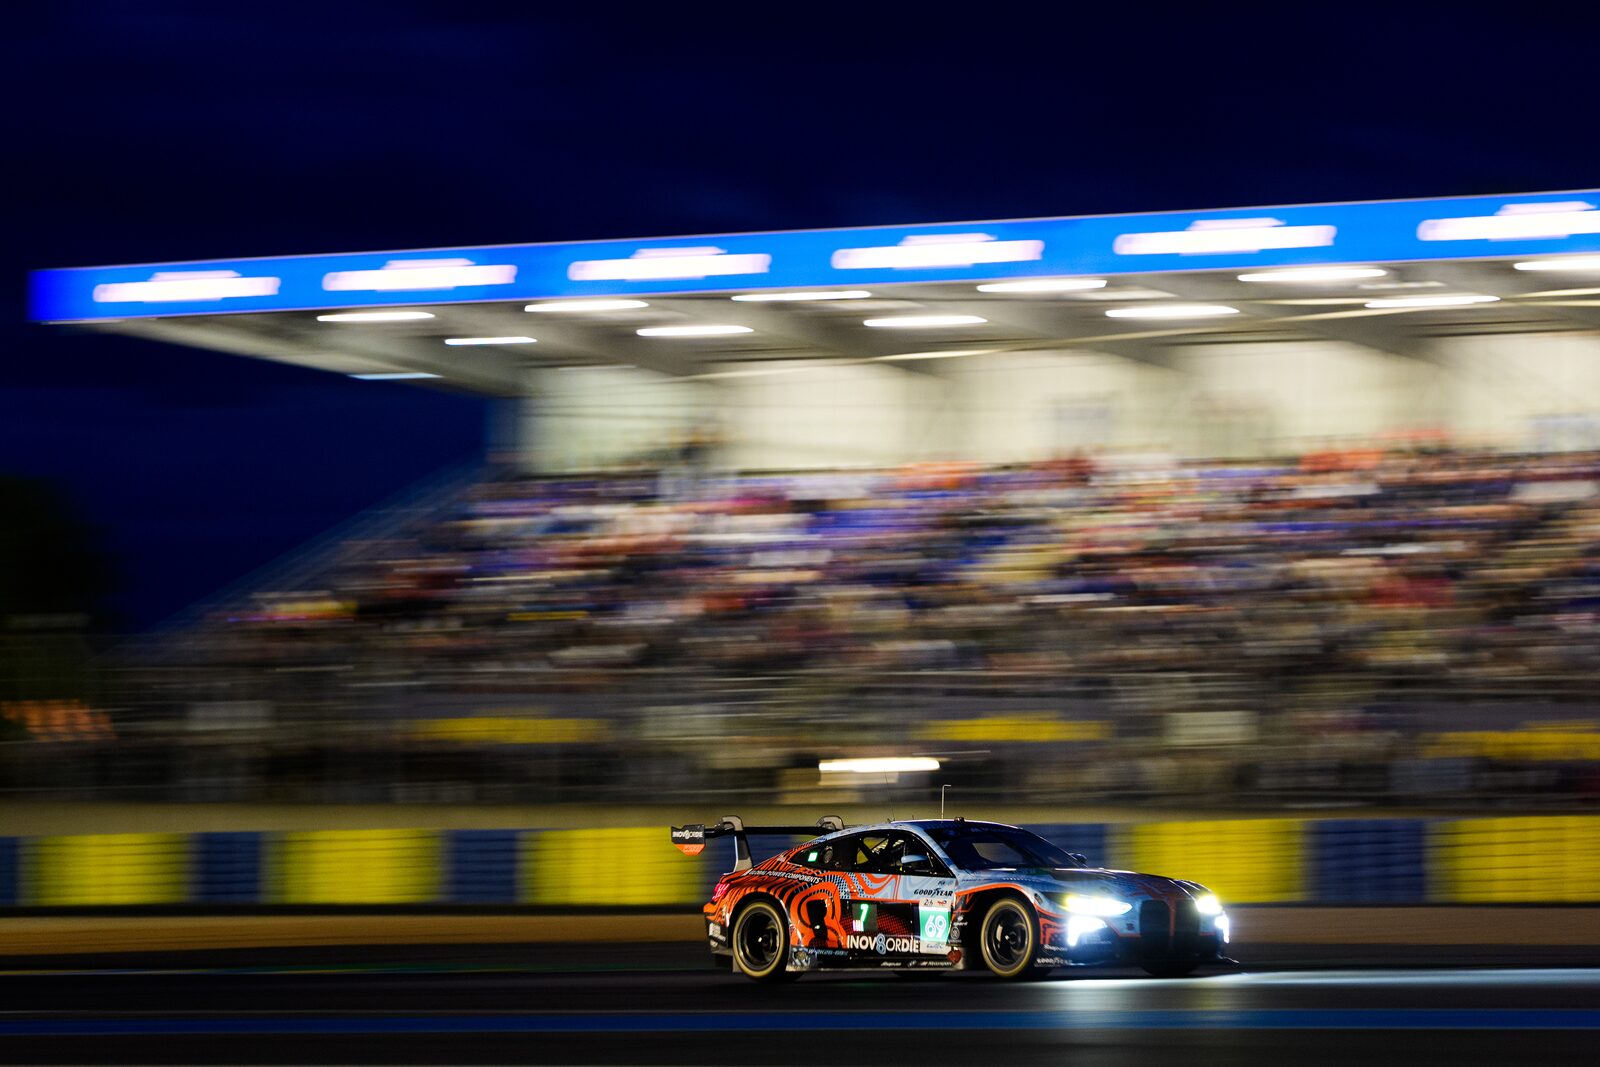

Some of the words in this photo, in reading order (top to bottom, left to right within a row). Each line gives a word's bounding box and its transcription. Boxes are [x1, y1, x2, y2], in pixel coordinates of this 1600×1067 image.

[785, 872, 821, 884] COMPONENTS
[914, 888, 953, 898] GOODYEAR
[924, 914, 947, 939] 69
[847, 933, 921, 955] INOV8ORDIE
